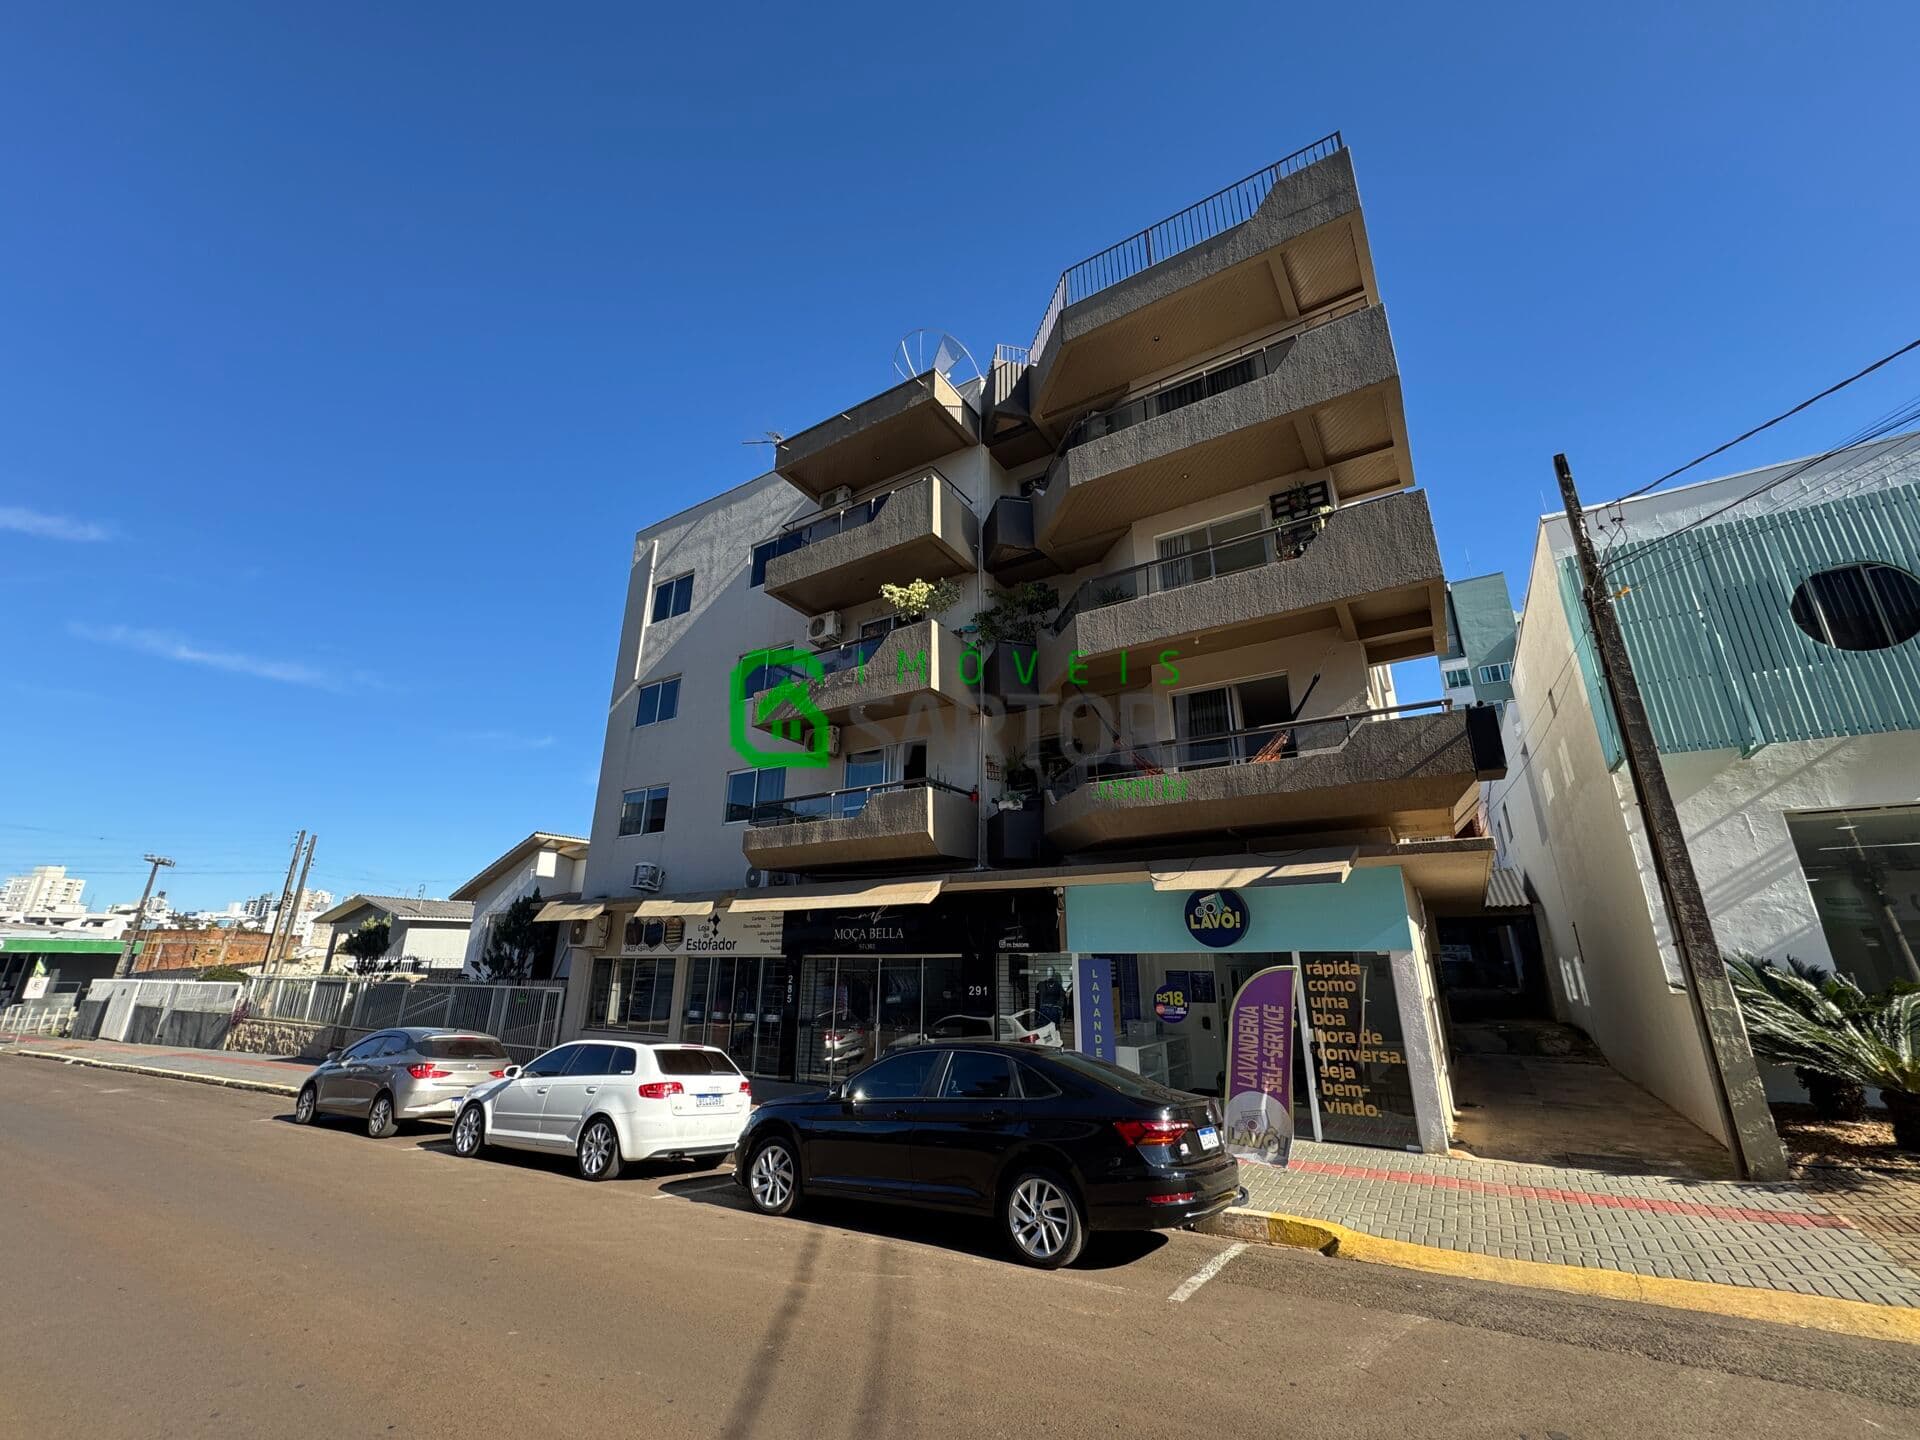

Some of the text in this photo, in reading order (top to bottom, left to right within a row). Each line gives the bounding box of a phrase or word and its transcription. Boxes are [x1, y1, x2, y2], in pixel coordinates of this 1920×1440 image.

[1189, 906, 1240, 929] LAVÔ!
[698, 924, 710, 932] Loja
[833, 927, 904, 941] MOÇA BELLA
[686, 938, 737, 950] Estofador
[1305, 960, 1361, 978] rápida
[968, 985, 988, 997] 291
[1308, 979, 1356, 992] como
[1310, 996, 1349, 1009] uma
[1312, 1010, 1346, 1026] boa
[1314, 1027, 1383, 1045] hora de
[1237, 1005, 1259, 1089] LAVANDERIA
[1261, 1004, 1285, 1093] SELF-SERVICE
[1317, 1047, 1407, 1064] conversa.
[1319, 1065, 1356, 1081] seja
[1321, 1080, 1370, 1097] bem-
[1324, 1099, 1383, 1118] vindo.
